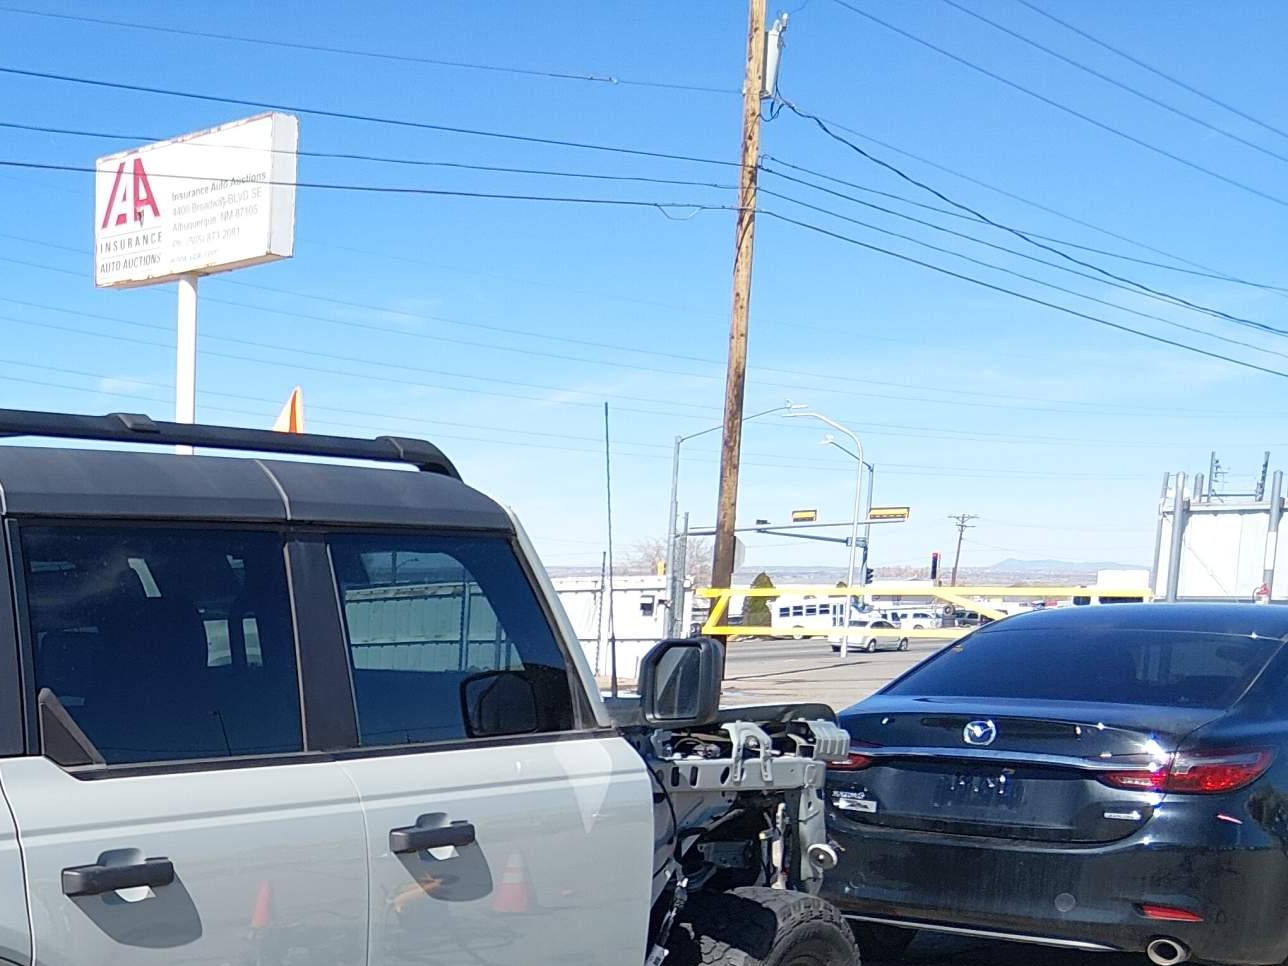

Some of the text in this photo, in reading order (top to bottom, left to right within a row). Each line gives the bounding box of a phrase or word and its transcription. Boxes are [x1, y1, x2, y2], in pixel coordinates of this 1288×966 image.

[171, 172, 266, 201] Insurance Auto Auctions
[251, 186, 263, 199] SE
[100, 232, 162, 254] INSURANCE
[100, 260, 122, 273] AUTO
[123, 254, 161, 270] AUCTIONS
